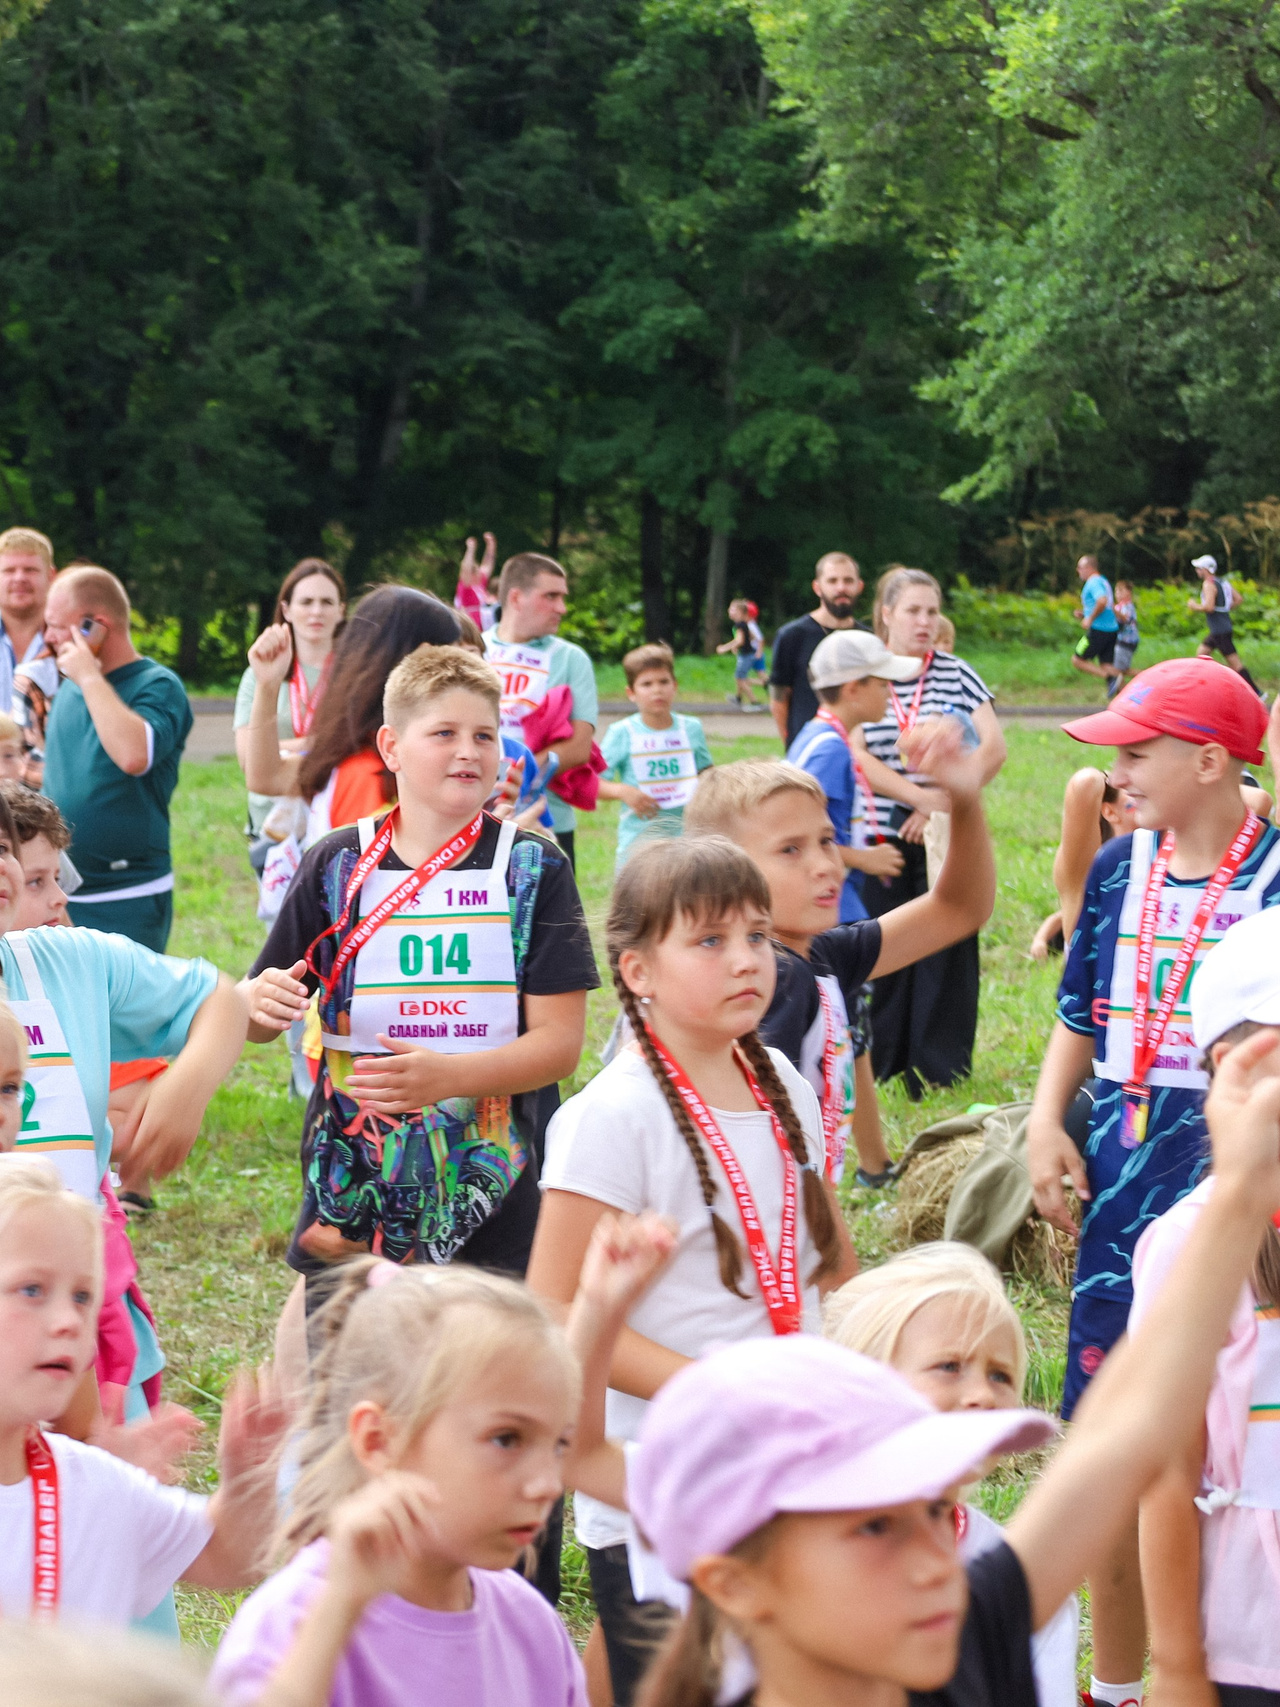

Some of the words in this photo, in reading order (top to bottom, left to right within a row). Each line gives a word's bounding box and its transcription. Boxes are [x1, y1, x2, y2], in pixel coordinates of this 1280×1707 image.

[505, 672, 530, 695] 10
[647, 758, 680, 777] 256
[422, 849, 456, 876] DKC
[443, 888, 453, 907] 1
[458, 890, 488, 906] КМ
[335, 874, 420, 970] #СЛАВНЫЙЗАБЕГ
[399, 932, 472, 977] 014
[422, 1000, 468, 1016] DKC
[388, 1022, 448, 1038] СЛАВНЫЙ
[454, 1024, 489, 1038] ЗАБЕГ
